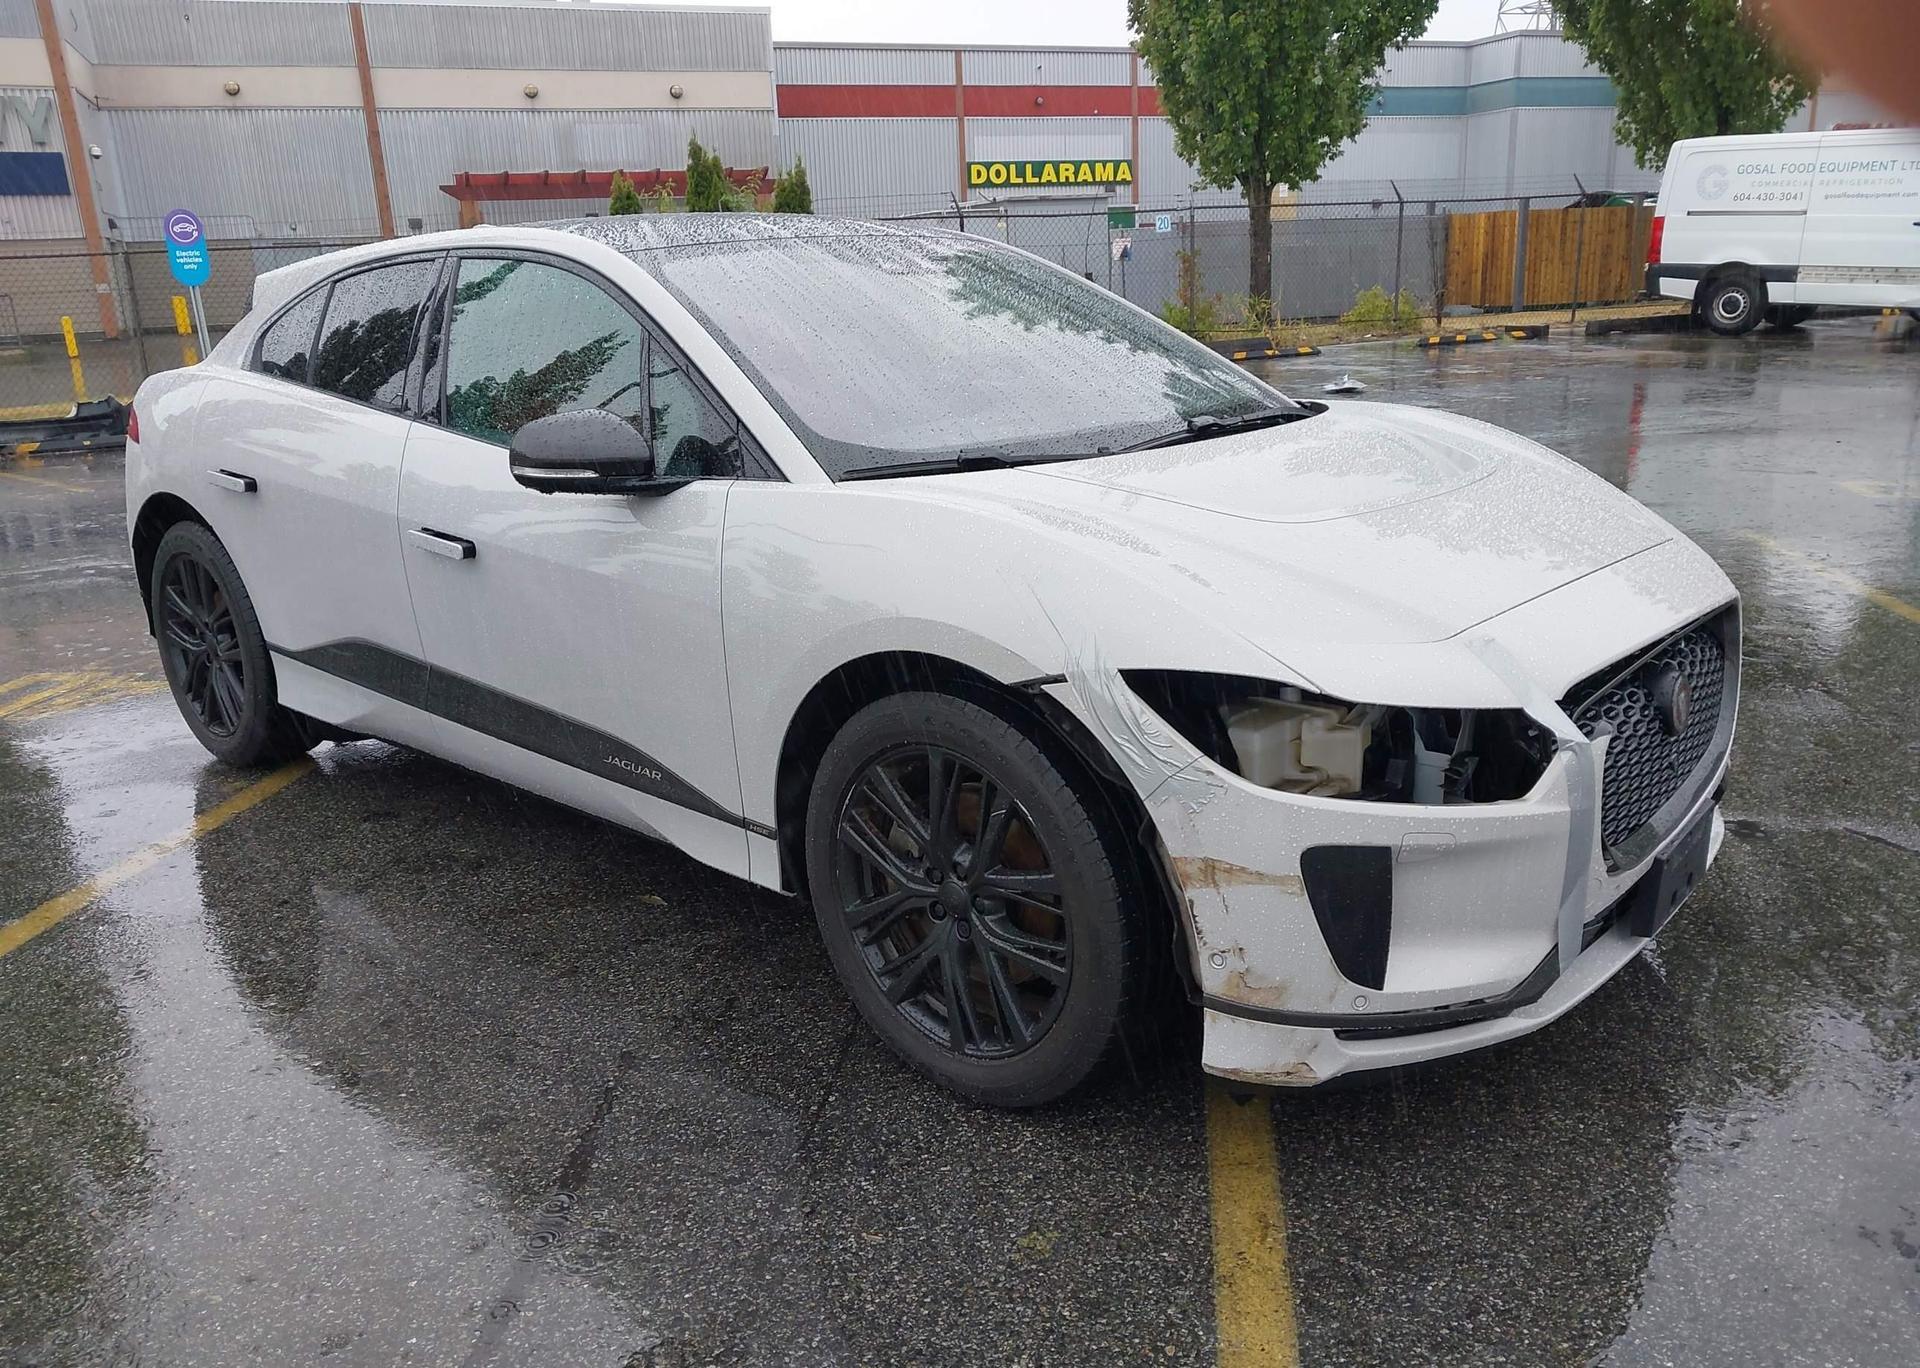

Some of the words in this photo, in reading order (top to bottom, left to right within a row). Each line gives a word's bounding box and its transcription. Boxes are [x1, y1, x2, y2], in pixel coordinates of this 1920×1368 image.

[970, 162, 1132, 184] DOLLARAMA
[1736, 163, 1777, 175] GOSAL
[1780, 162, 1816, 174] FOOD
[1818, 159, 1898, 173] EQUIPMENT
[1751, 179, 1814, 188] COMMERCIAL
[1818, 178, 1904, 187] REFRIGERATION
[1732, 191, 1804, 202] 604-430-3041
[1824, 190, 1918, 200] gosalfoodequipment.com
[1157, 216, 1170, 230] 20
[183, 263, 198, 271] only
[603, 755, 663, 781] JAGUAR
